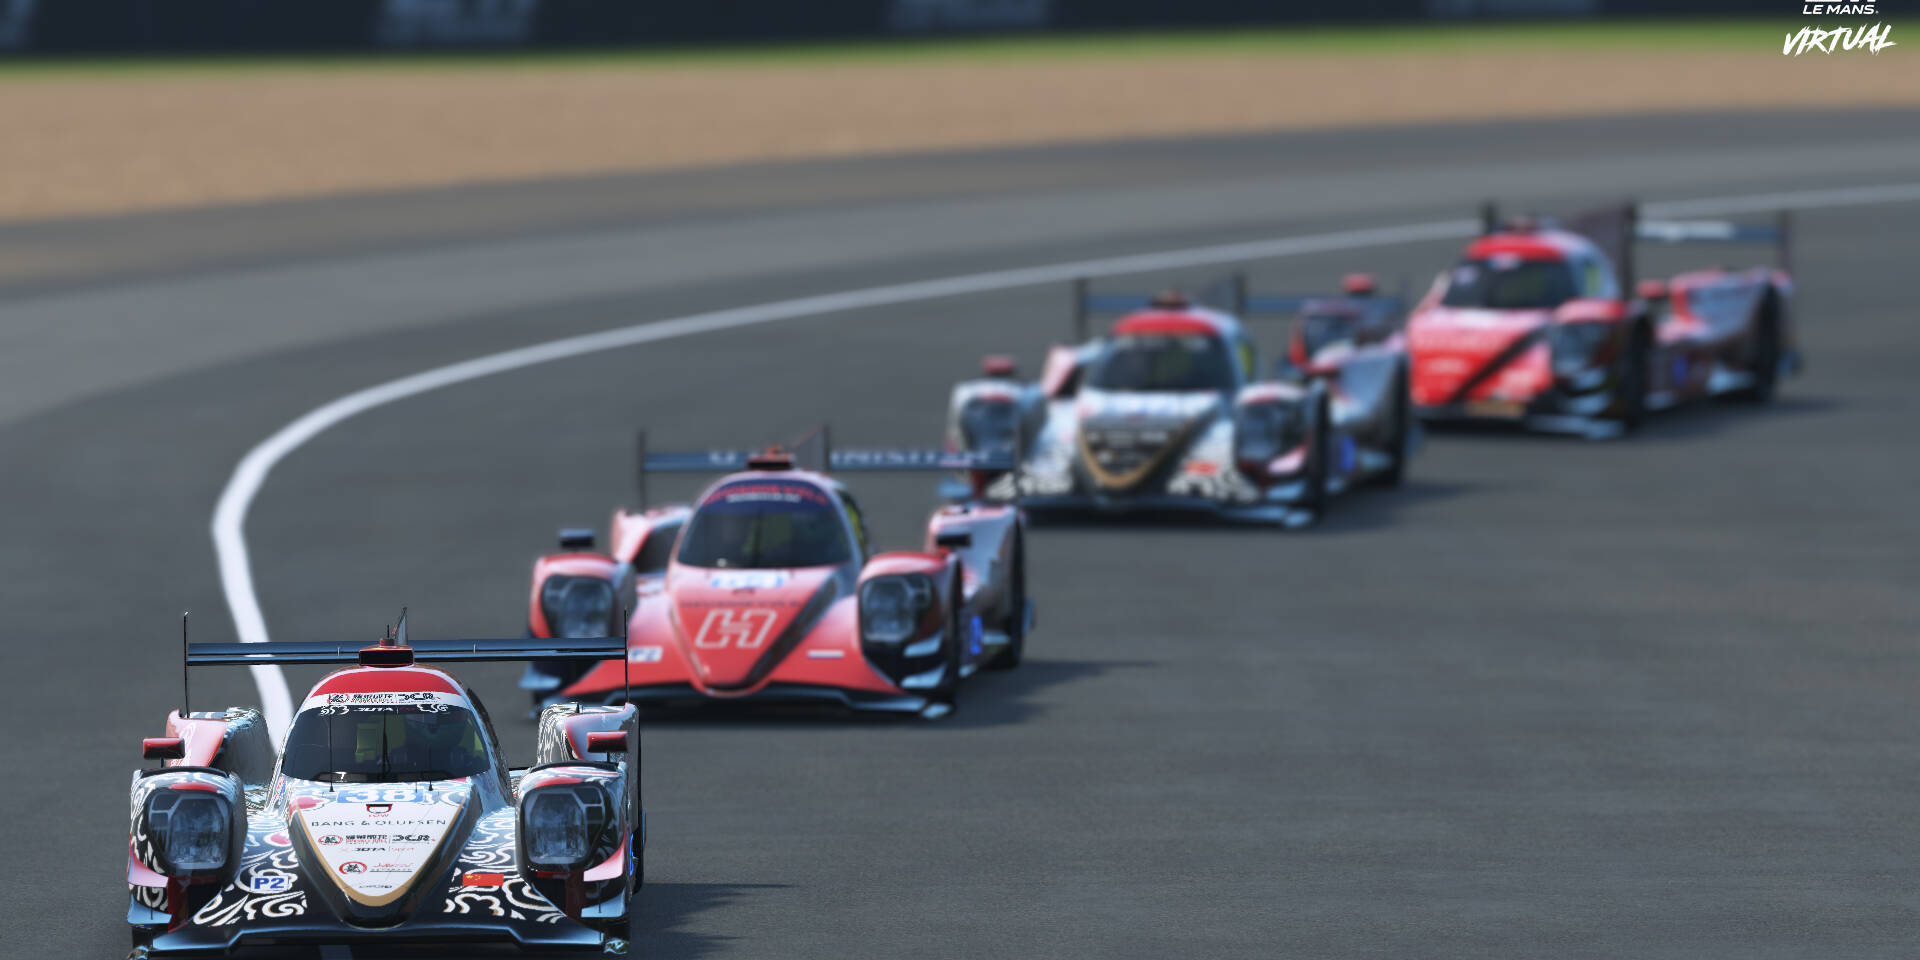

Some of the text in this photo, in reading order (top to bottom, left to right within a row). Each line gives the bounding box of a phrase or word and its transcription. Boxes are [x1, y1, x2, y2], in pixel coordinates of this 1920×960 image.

[345, 789, 417, 802] 38
[360, 819, 371, 827] &
[375, 819, 447, 827] OLUFSEN
[254, 877, 285, 890] P2
